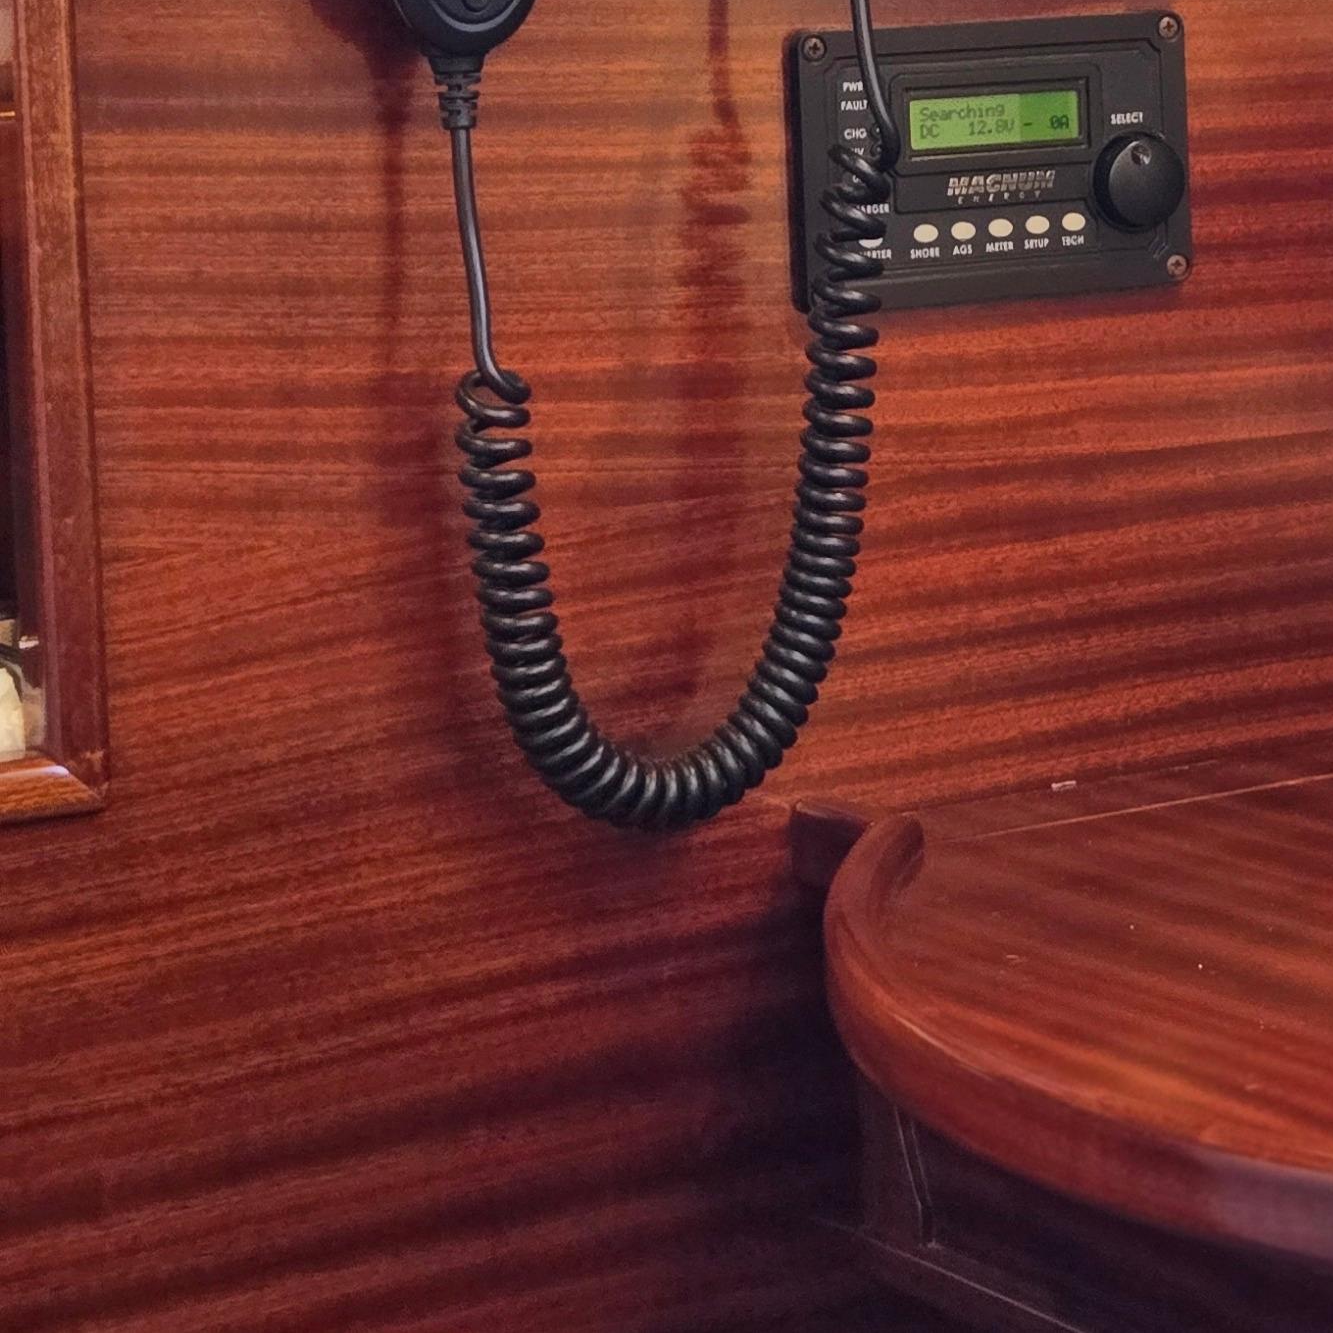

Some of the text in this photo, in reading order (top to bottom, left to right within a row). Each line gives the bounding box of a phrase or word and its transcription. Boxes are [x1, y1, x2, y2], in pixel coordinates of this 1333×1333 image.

[843, 82, 864, 92] PWR
[841, 99, 868, 111] FAULT
[919, 104, 1005, 122] Searching
[1111, 112, 1143, 125] SELECT
[844, 128, 867, 140] CHG
[920, 125, 940, 139] DC
[947, 170, 1056, 196] MAGNUM
[958, 190, 1041, 204] ENERGY
[1024, 238, 1049, 249] SETUP
[1062, 235, 1084, 246] TECH
[910, 247, 940, 259] SHORE
[953, 244, 973, 256] AGS
[986, 241, 1014, 253] METER
